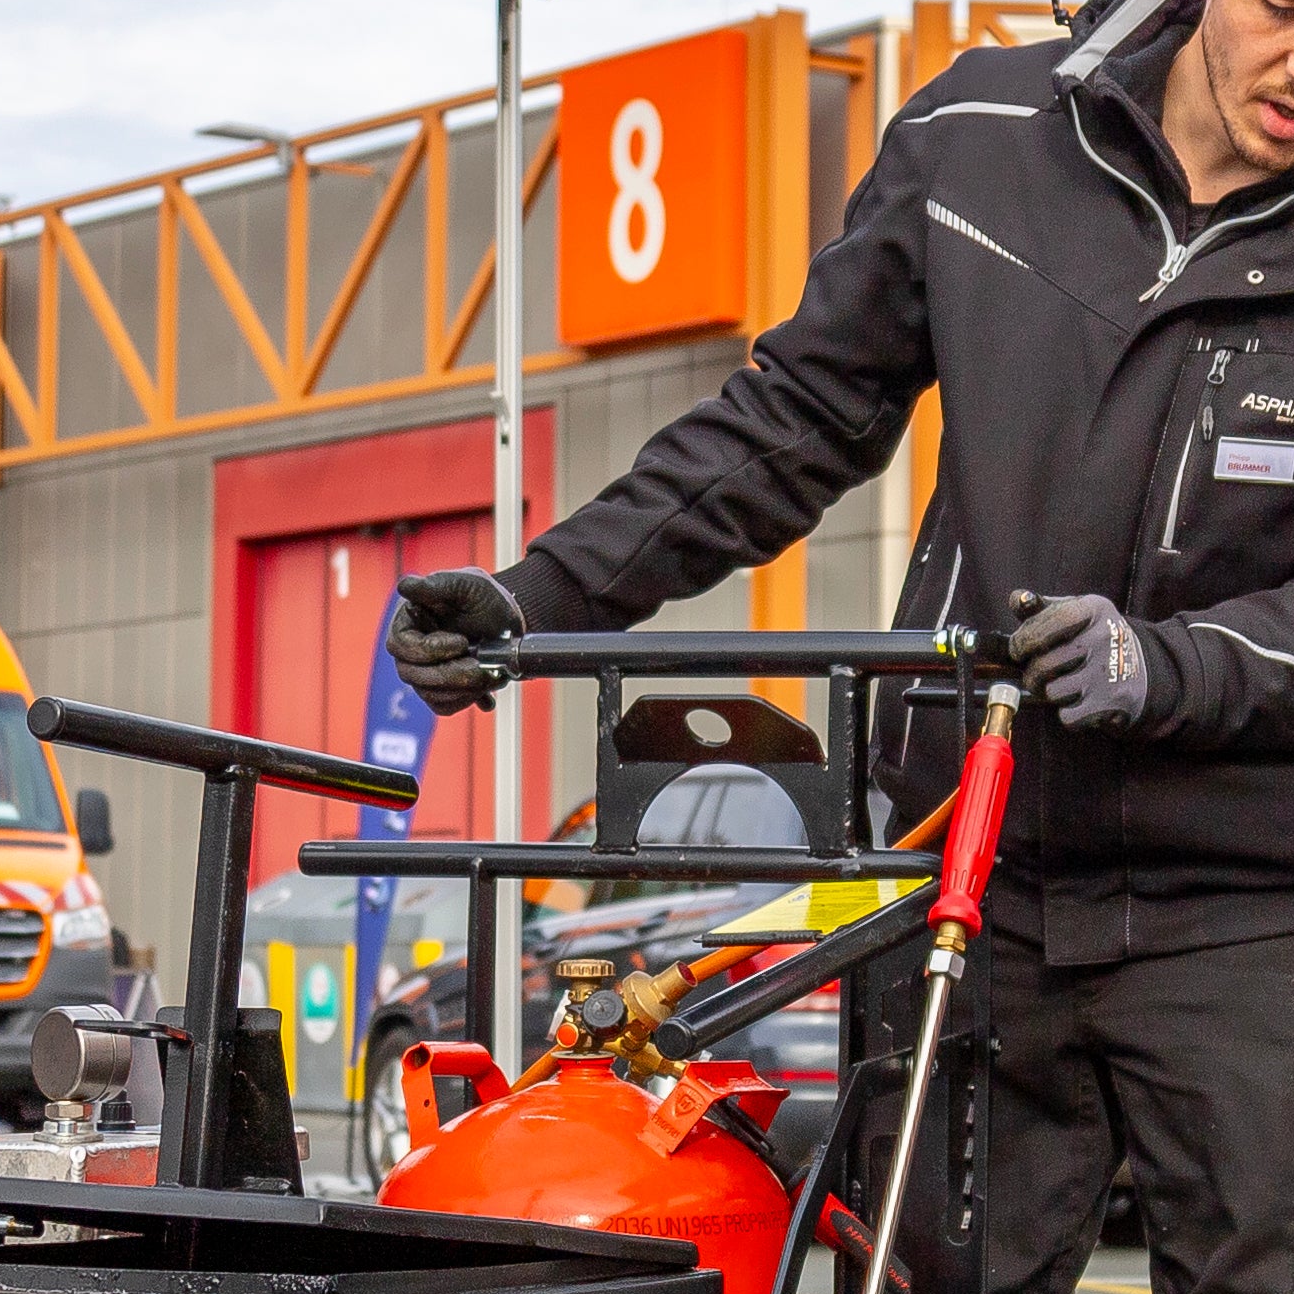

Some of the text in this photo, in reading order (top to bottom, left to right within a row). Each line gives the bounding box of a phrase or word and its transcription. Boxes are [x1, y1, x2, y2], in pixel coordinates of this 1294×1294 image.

[609, 97, 666, 284] 8
[331, 547, 350, 599] 1
[657, 1215, 722, 1237] UN1965
